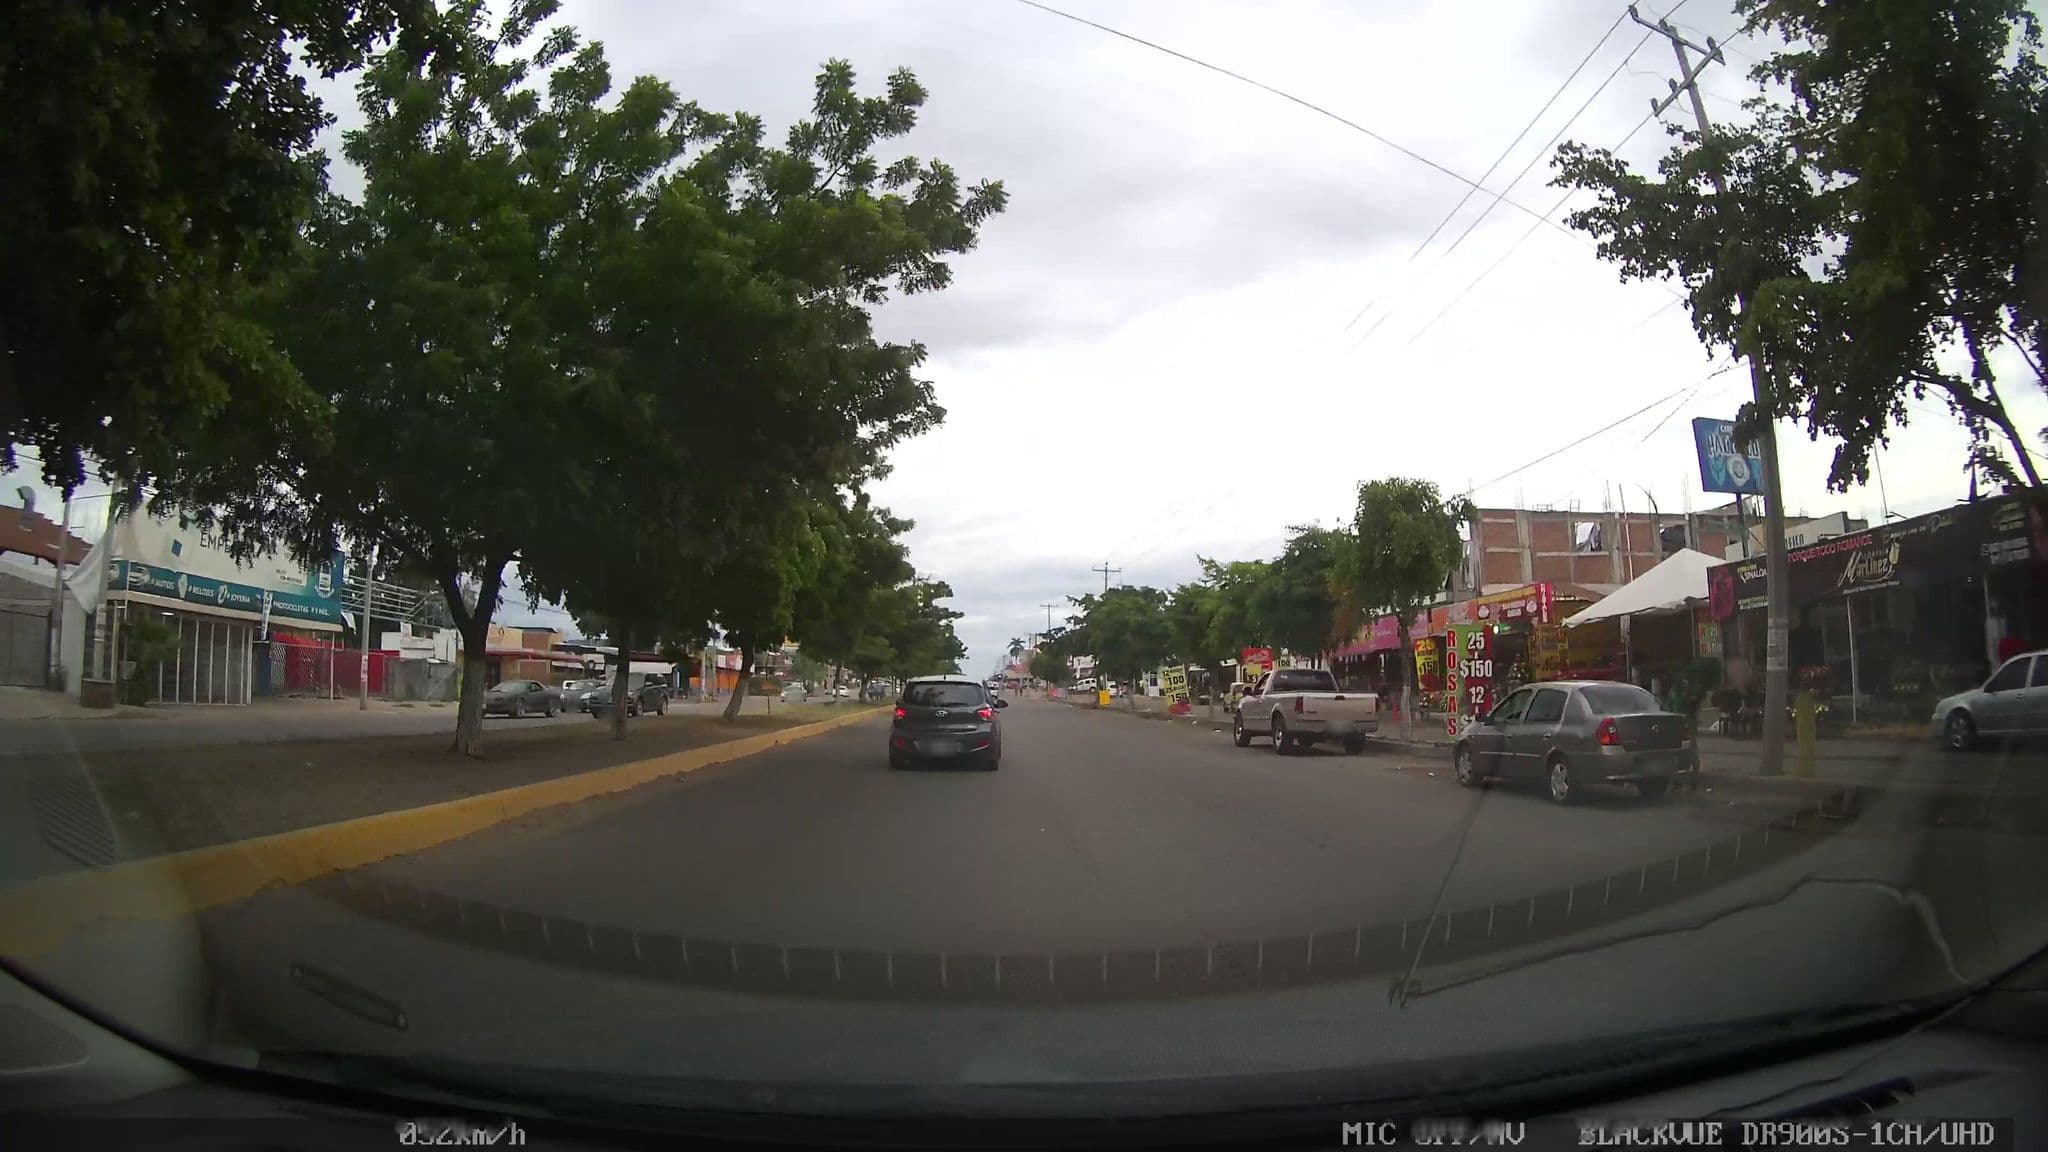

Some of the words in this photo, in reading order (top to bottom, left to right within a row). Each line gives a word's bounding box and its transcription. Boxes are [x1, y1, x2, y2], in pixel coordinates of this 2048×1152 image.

[1467, 631, 1485, 650] 25
[1460, 659, 1493, 678] $150
[1168, 675, 1184, 686] 100
[1446, 629, 1458, 736] ROSAS
[1469, 686, 1485, 704] 12
